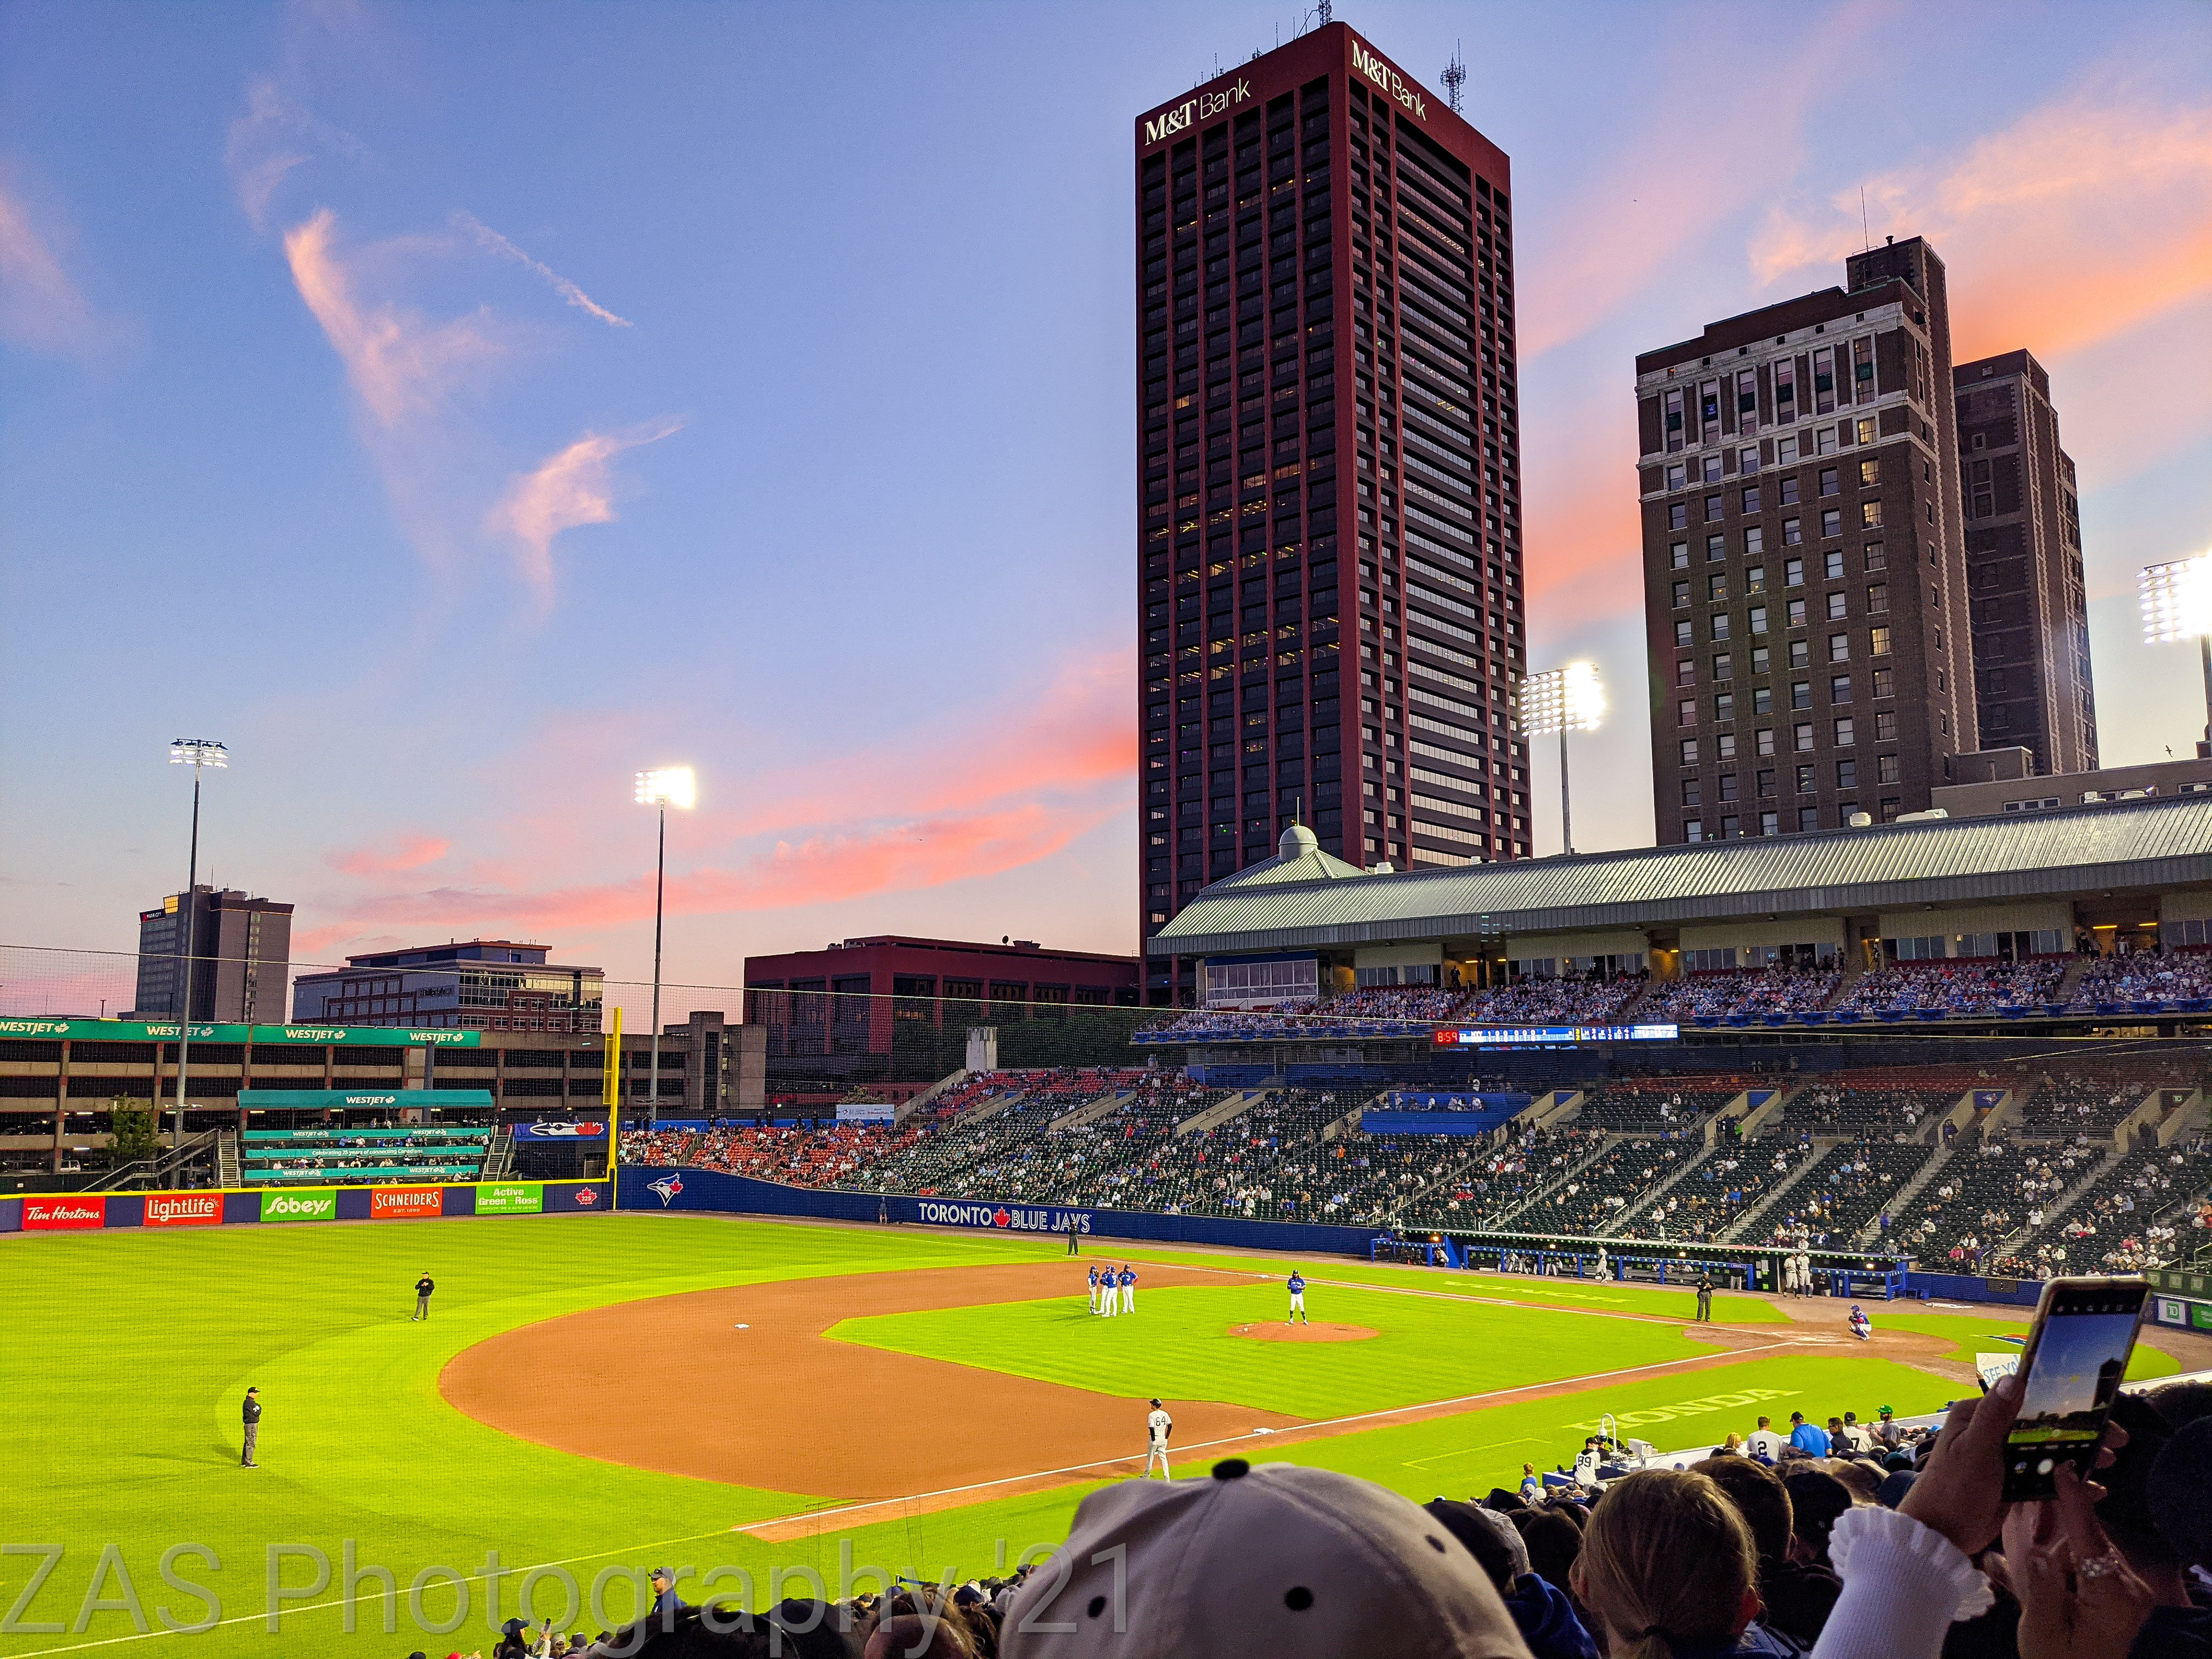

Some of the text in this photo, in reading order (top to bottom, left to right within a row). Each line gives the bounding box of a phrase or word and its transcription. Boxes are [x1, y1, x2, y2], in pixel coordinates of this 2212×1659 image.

[1352, 40, 1426, 122] M&T Bank
[1145, 78, 1251, 146] M&T Bank
[146, 1025, 200, 1039] WESTET
[285, 1029, 334, 1041] WESTJET
[410, 1032, 453, 1044] WESTJET
[1438, 1032, 1457, 1041] 8:59
[346, 1096, 385, 1106] WESTJET
[493, 1187, 524, 1196] Active
[266, 1195, 332, 1215] Sobeys
[375, 1191, 439, 1209] SCHNEIDERS
[27, 1206, 100, 1220] Tim Hortons
[148, 1198, 215, 1222] Lightlife
[919, 1203, 992, 1226] TORONTO
[1011, 1209, 1048, 1230] BLUE
[1561, 1388, 1804, 1433] HONDA
[1156, 1415, 1166, 1426] 64
[1758, 1441, 1767, 1455] 2
[1578, 1456, 1592, 1467] 89
